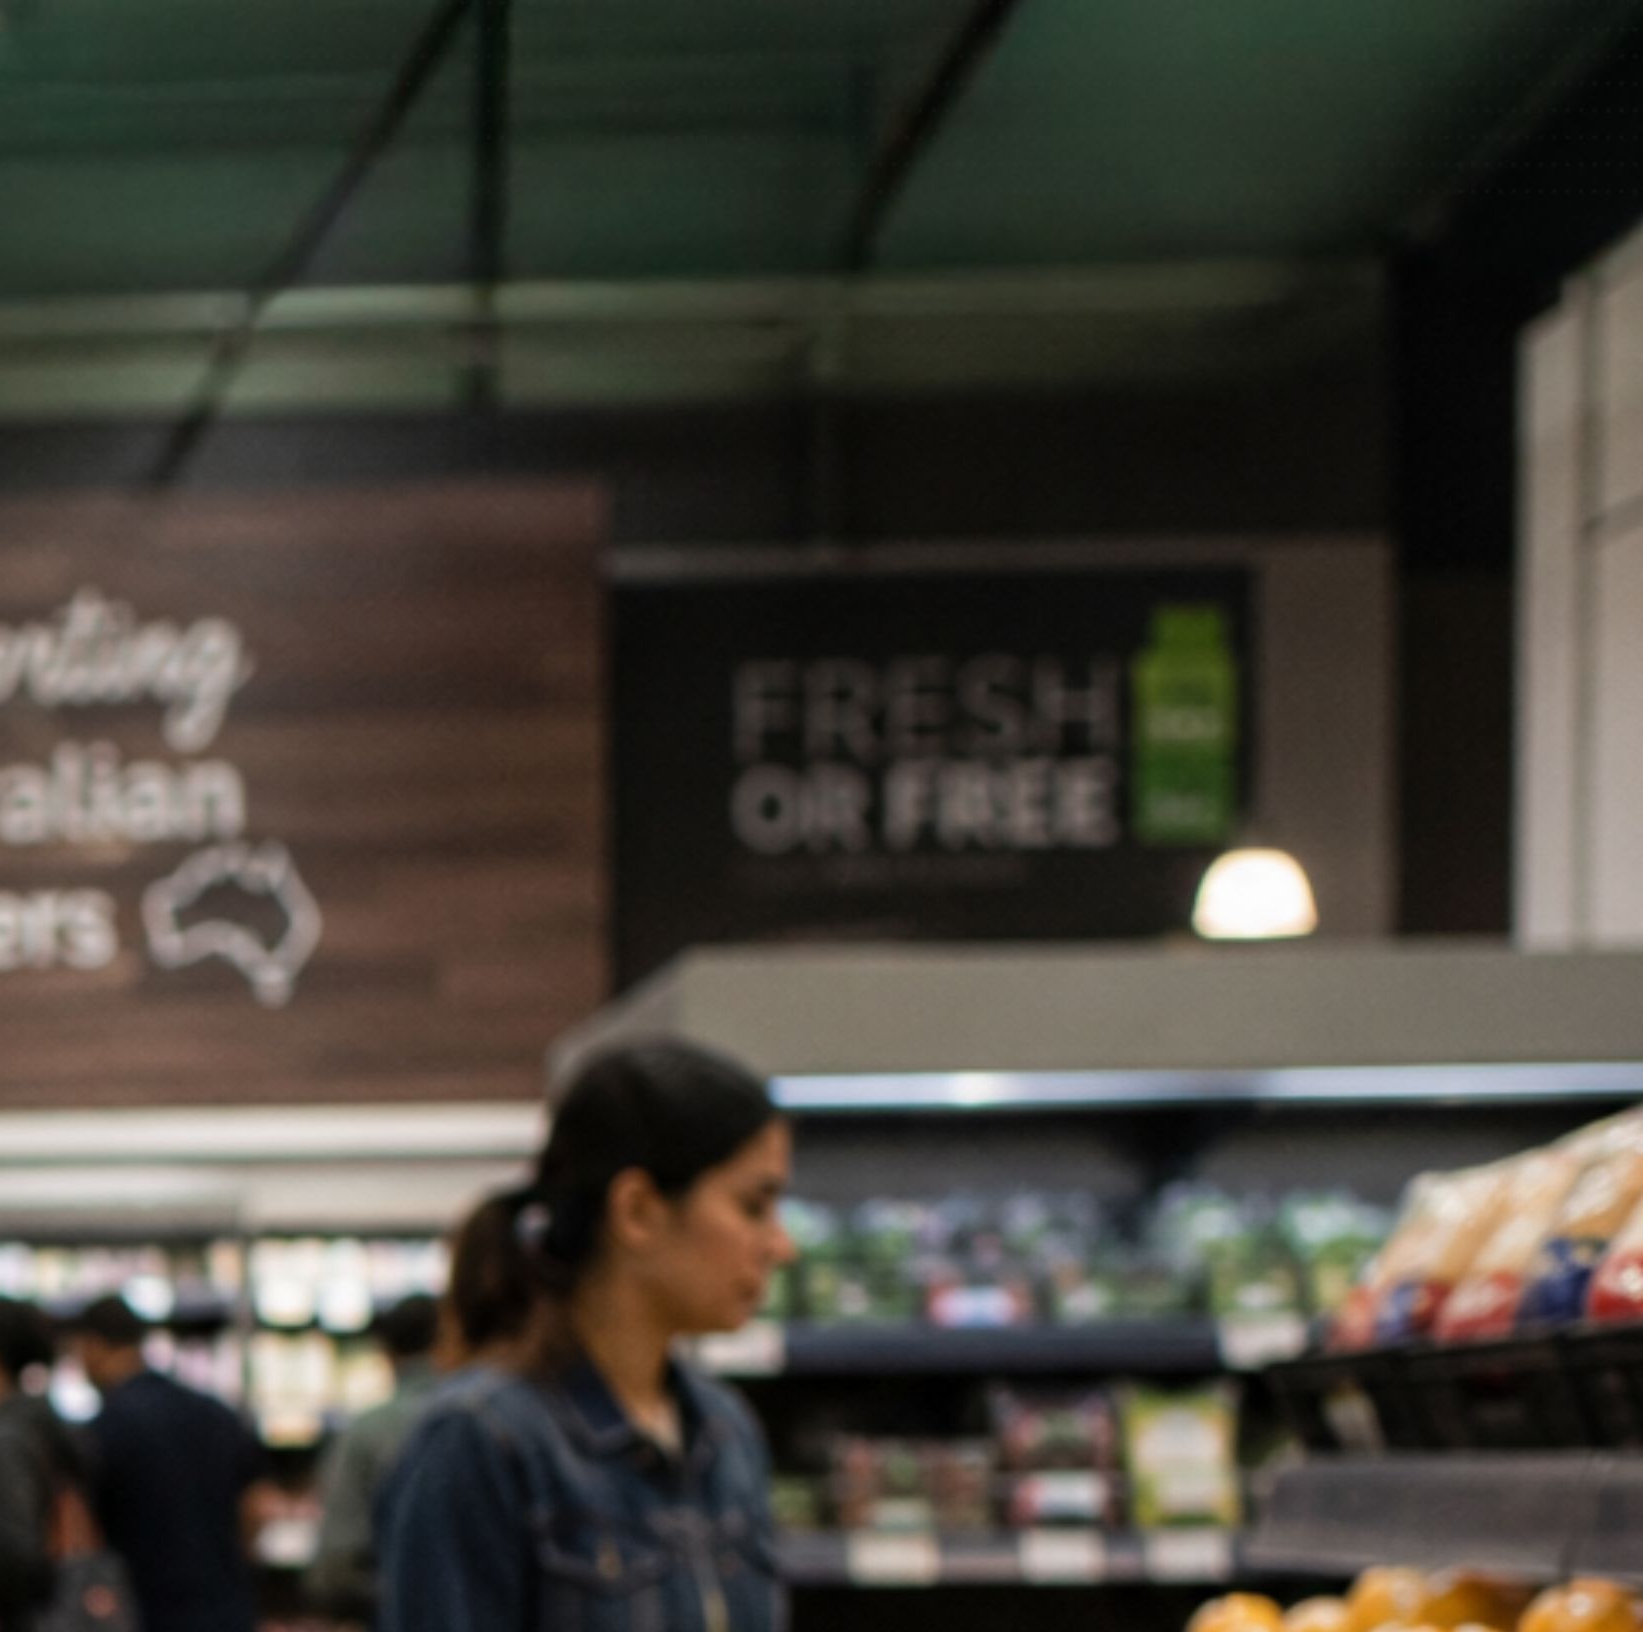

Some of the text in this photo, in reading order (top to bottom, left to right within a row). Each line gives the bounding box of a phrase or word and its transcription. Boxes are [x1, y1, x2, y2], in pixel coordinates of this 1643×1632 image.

[731, 656, 1117, 766] FRESH
[730, 757, 1117, 854] OR FREE
